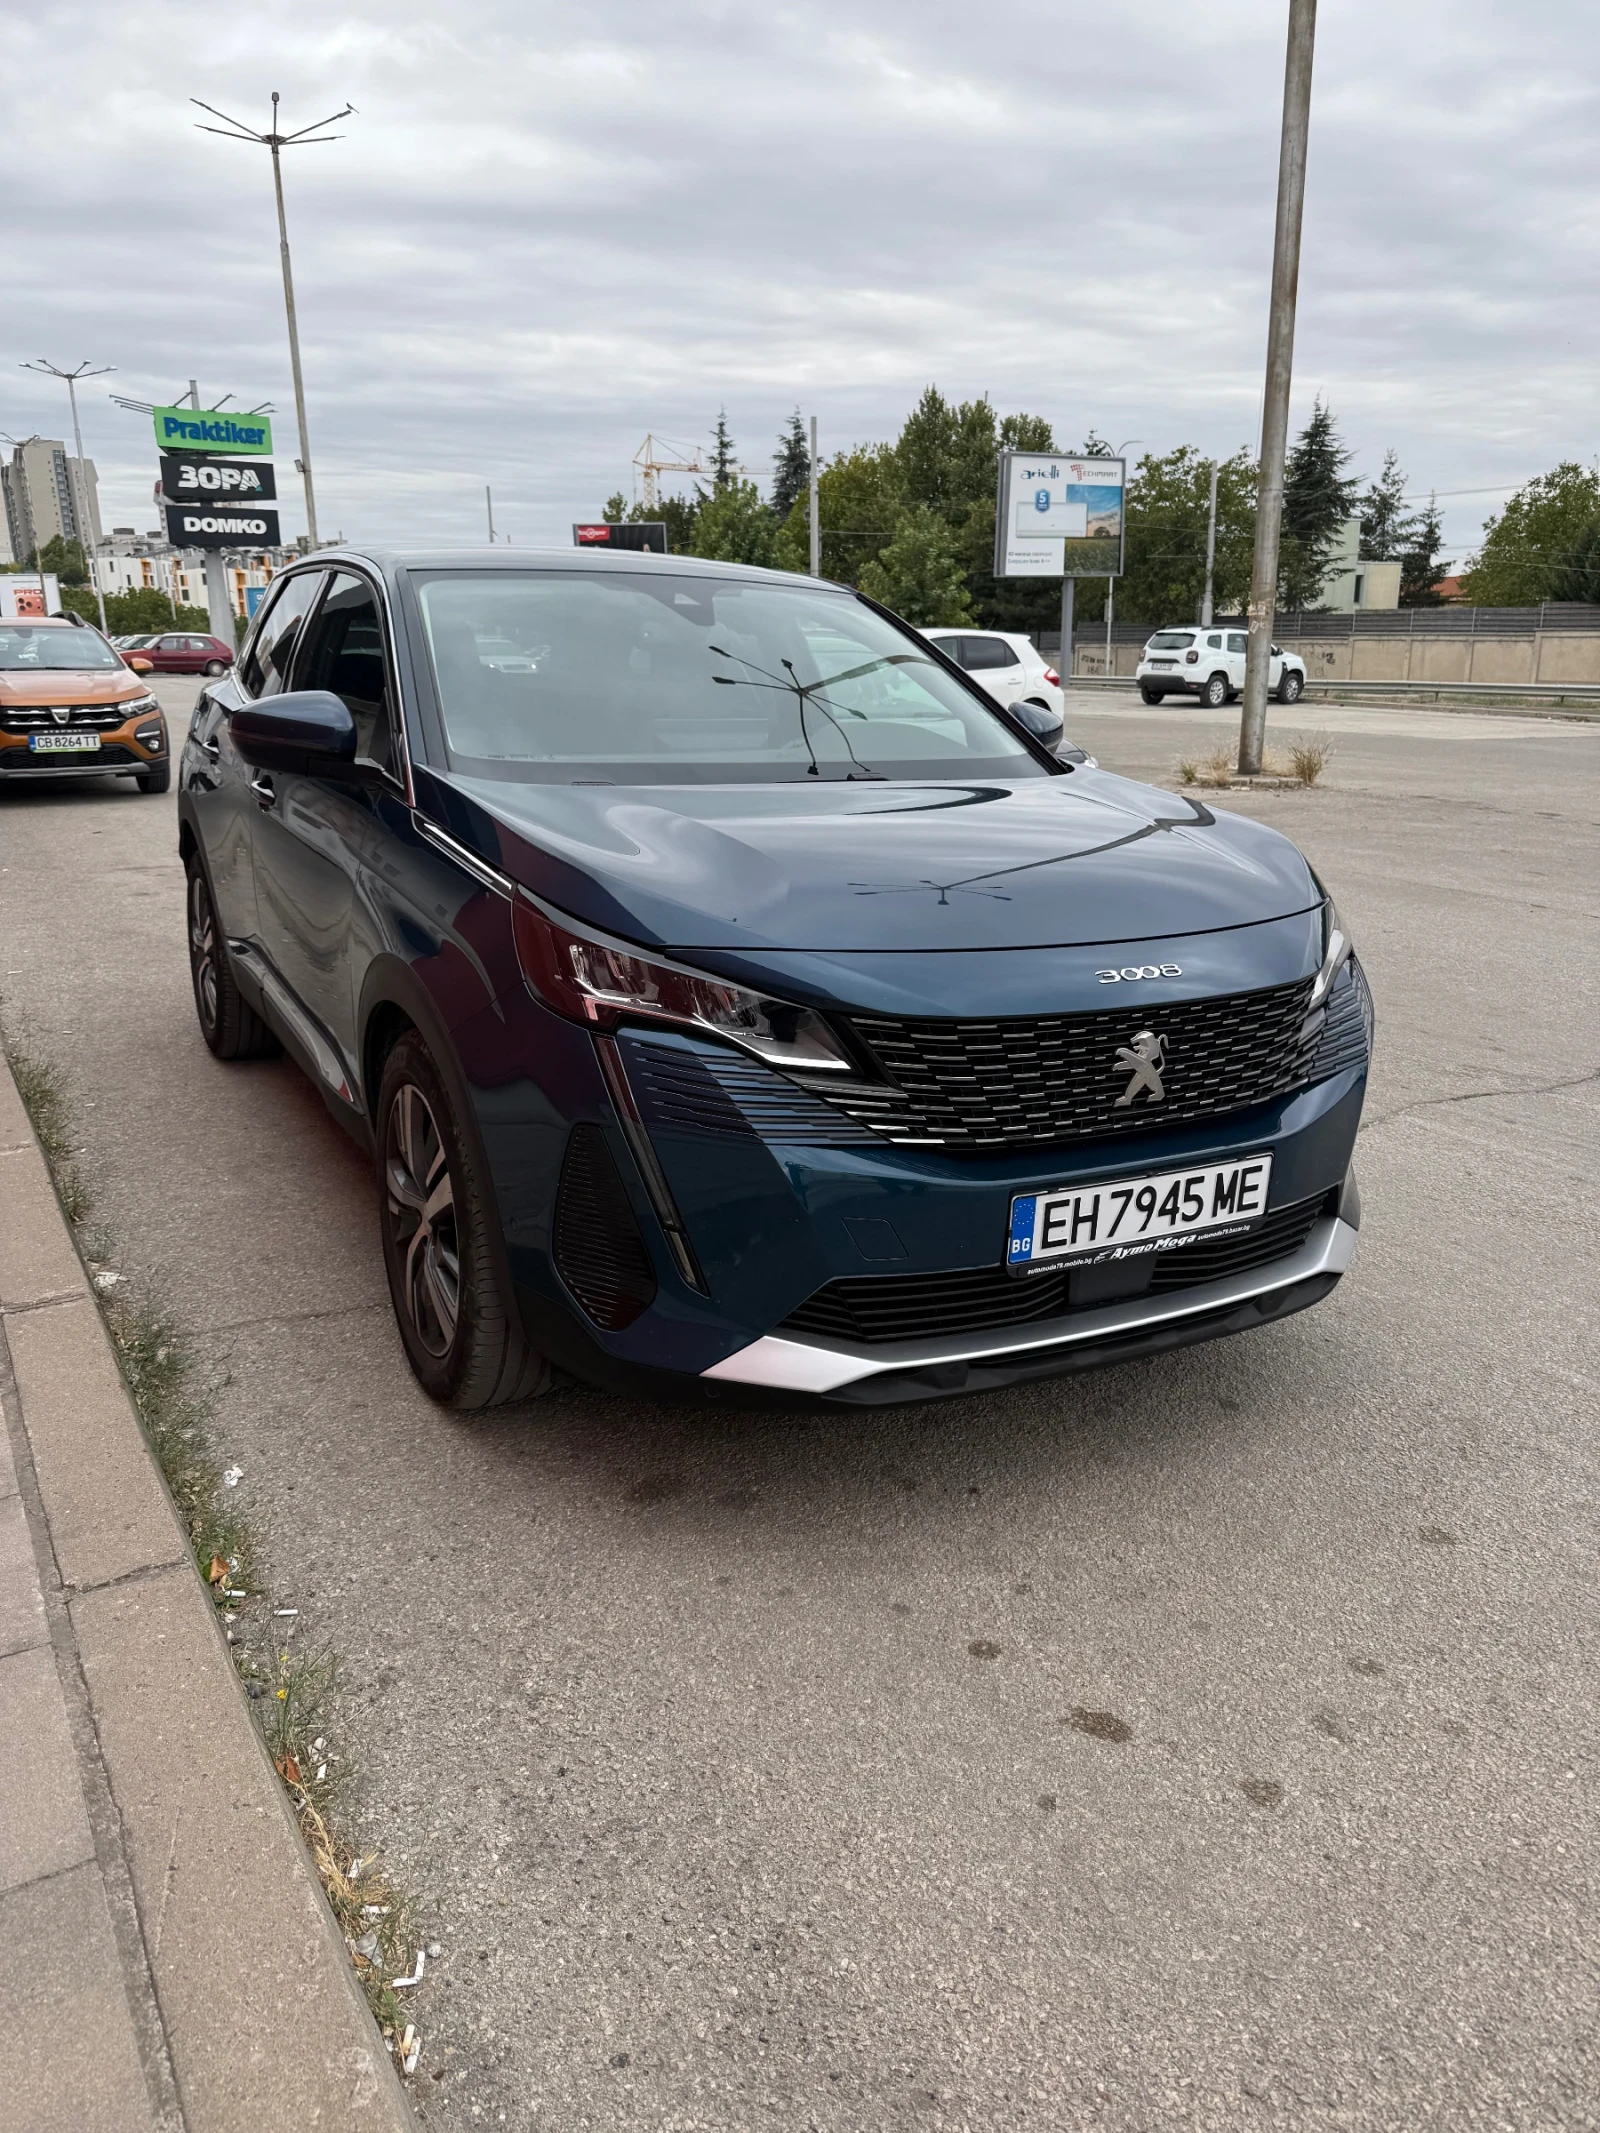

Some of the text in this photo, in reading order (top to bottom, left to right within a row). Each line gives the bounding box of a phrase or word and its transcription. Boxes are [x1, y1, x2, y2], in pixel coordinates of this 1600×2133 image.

[163, 416, 265, 445] Praktiker
[1020, 464, 1060, 480] arielli
[1039, 492, 1047, 503] 5
[183, 516, 267, 534] DOMKO
[37, 736, 98, 748] CB 8264 TT
[1094, 963, 1183, 984] 3008
[1041, 1164, 1263, 1250] EH 7945 ME
[1011, 1237, 1031, 1254] BG
